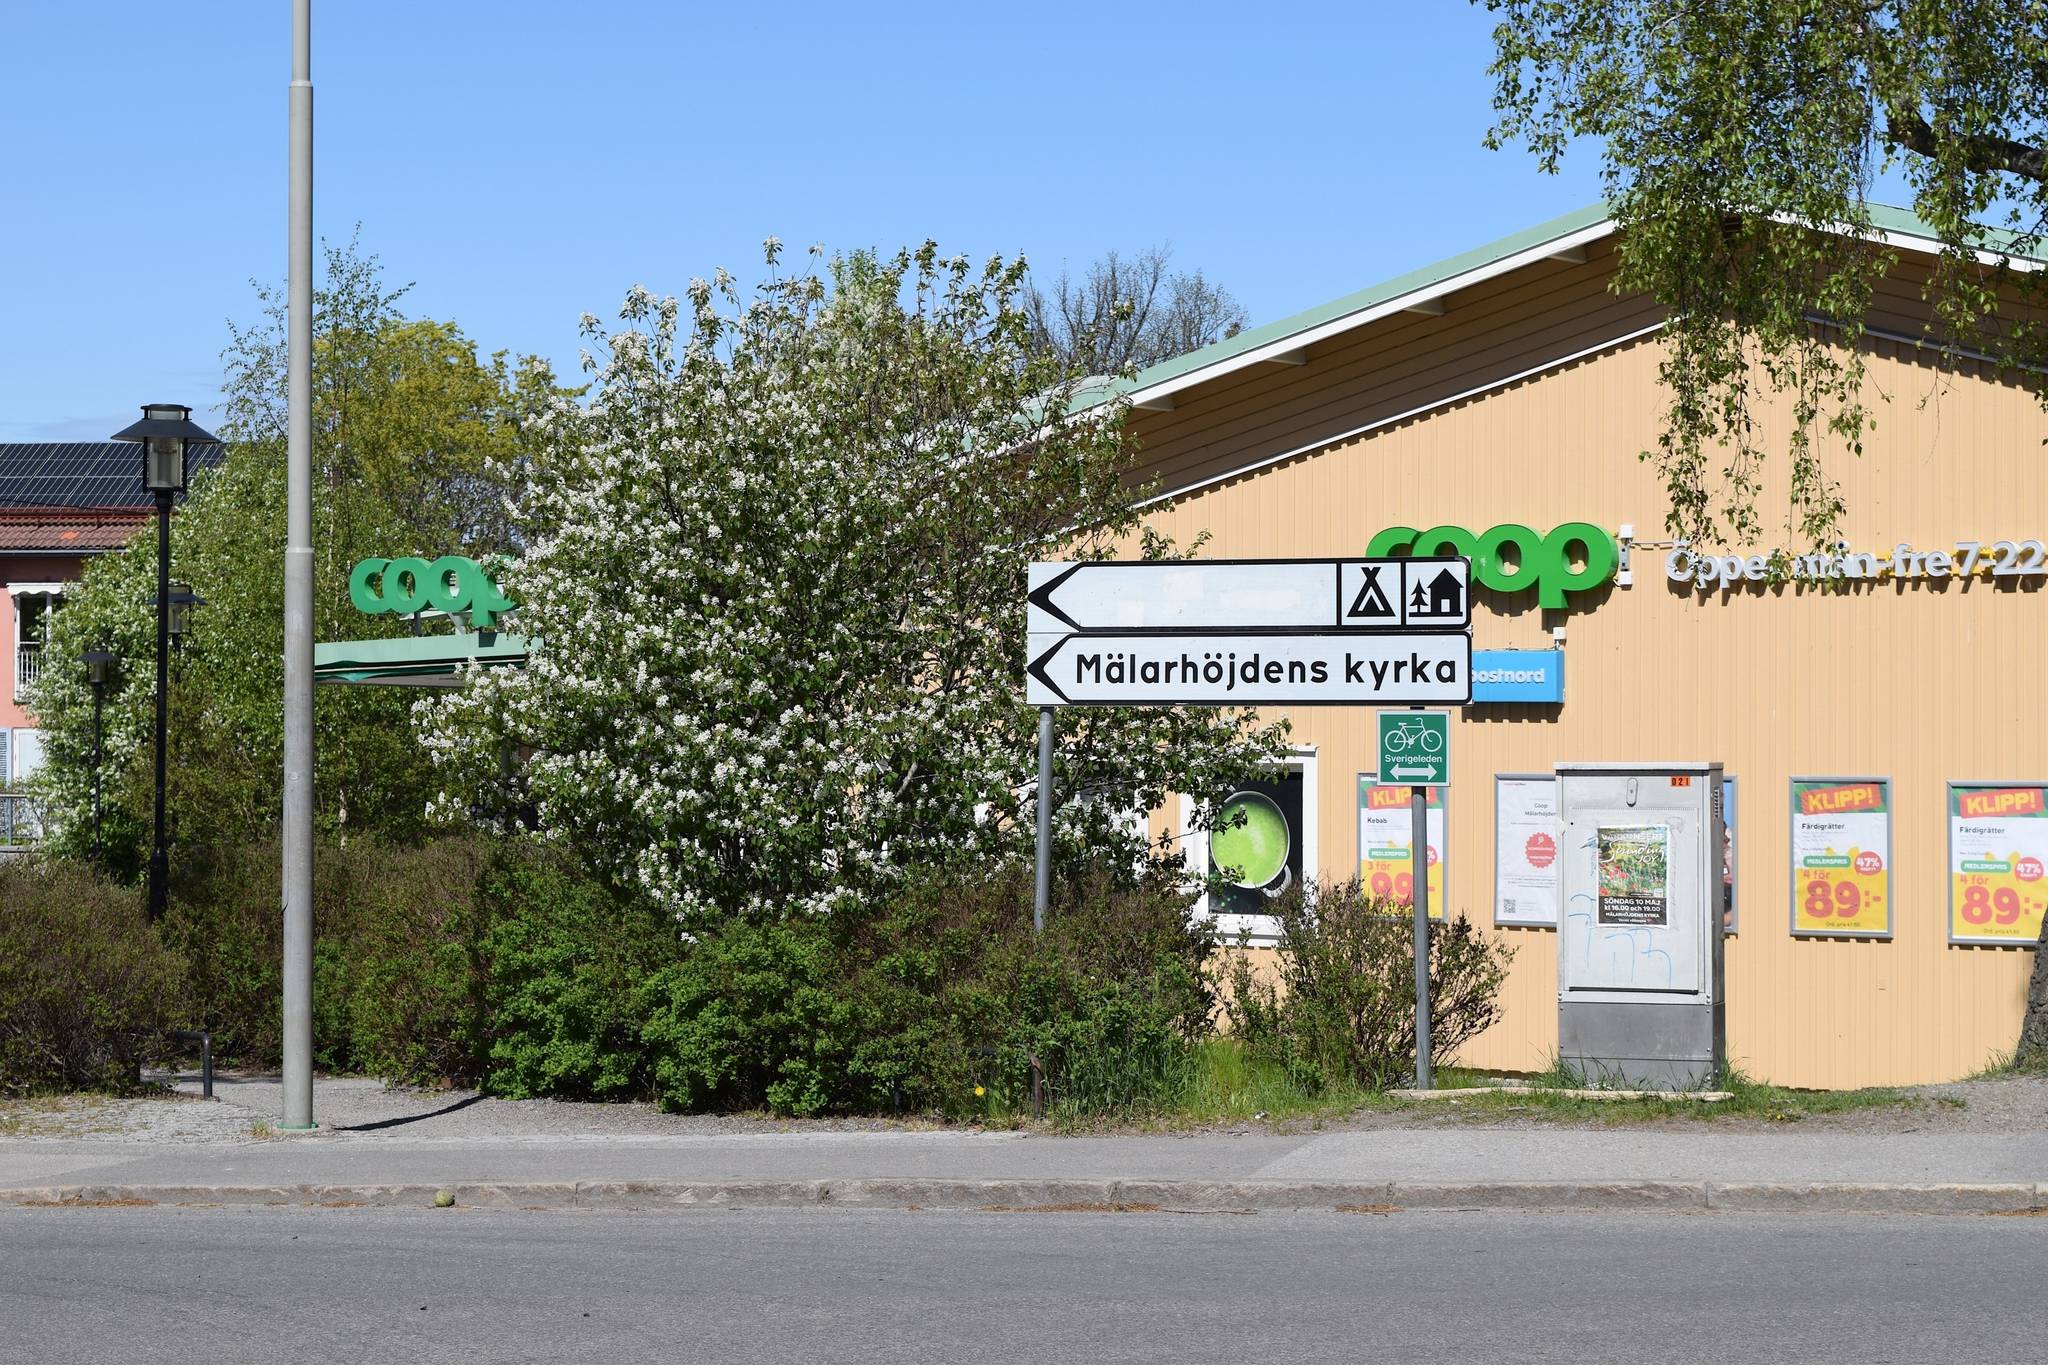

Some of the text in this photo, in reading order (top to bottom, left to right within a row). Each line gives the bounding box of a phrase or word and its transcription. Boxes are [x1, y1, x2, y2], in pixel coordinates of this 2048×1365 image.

[1665, 538, 1786, 588] Öppe
[1077, 653, 1456, 691] Mälarhöjdens kyrka
[1385, 754, 1442, 764] Sverigeleden
[1807, 786, 1874, 812] KLIPP!
[1966, 791, 2037, 815] KLIPP!
[1856, 857, 1880, 867] 47%
[2016, 863, 2042, 873] 47%
[1604, 897, 1634, 905] SÖNDAG
[1804, 880, 1881, 918] 89:-
[1961, 886, 2043, 925] 89:-
